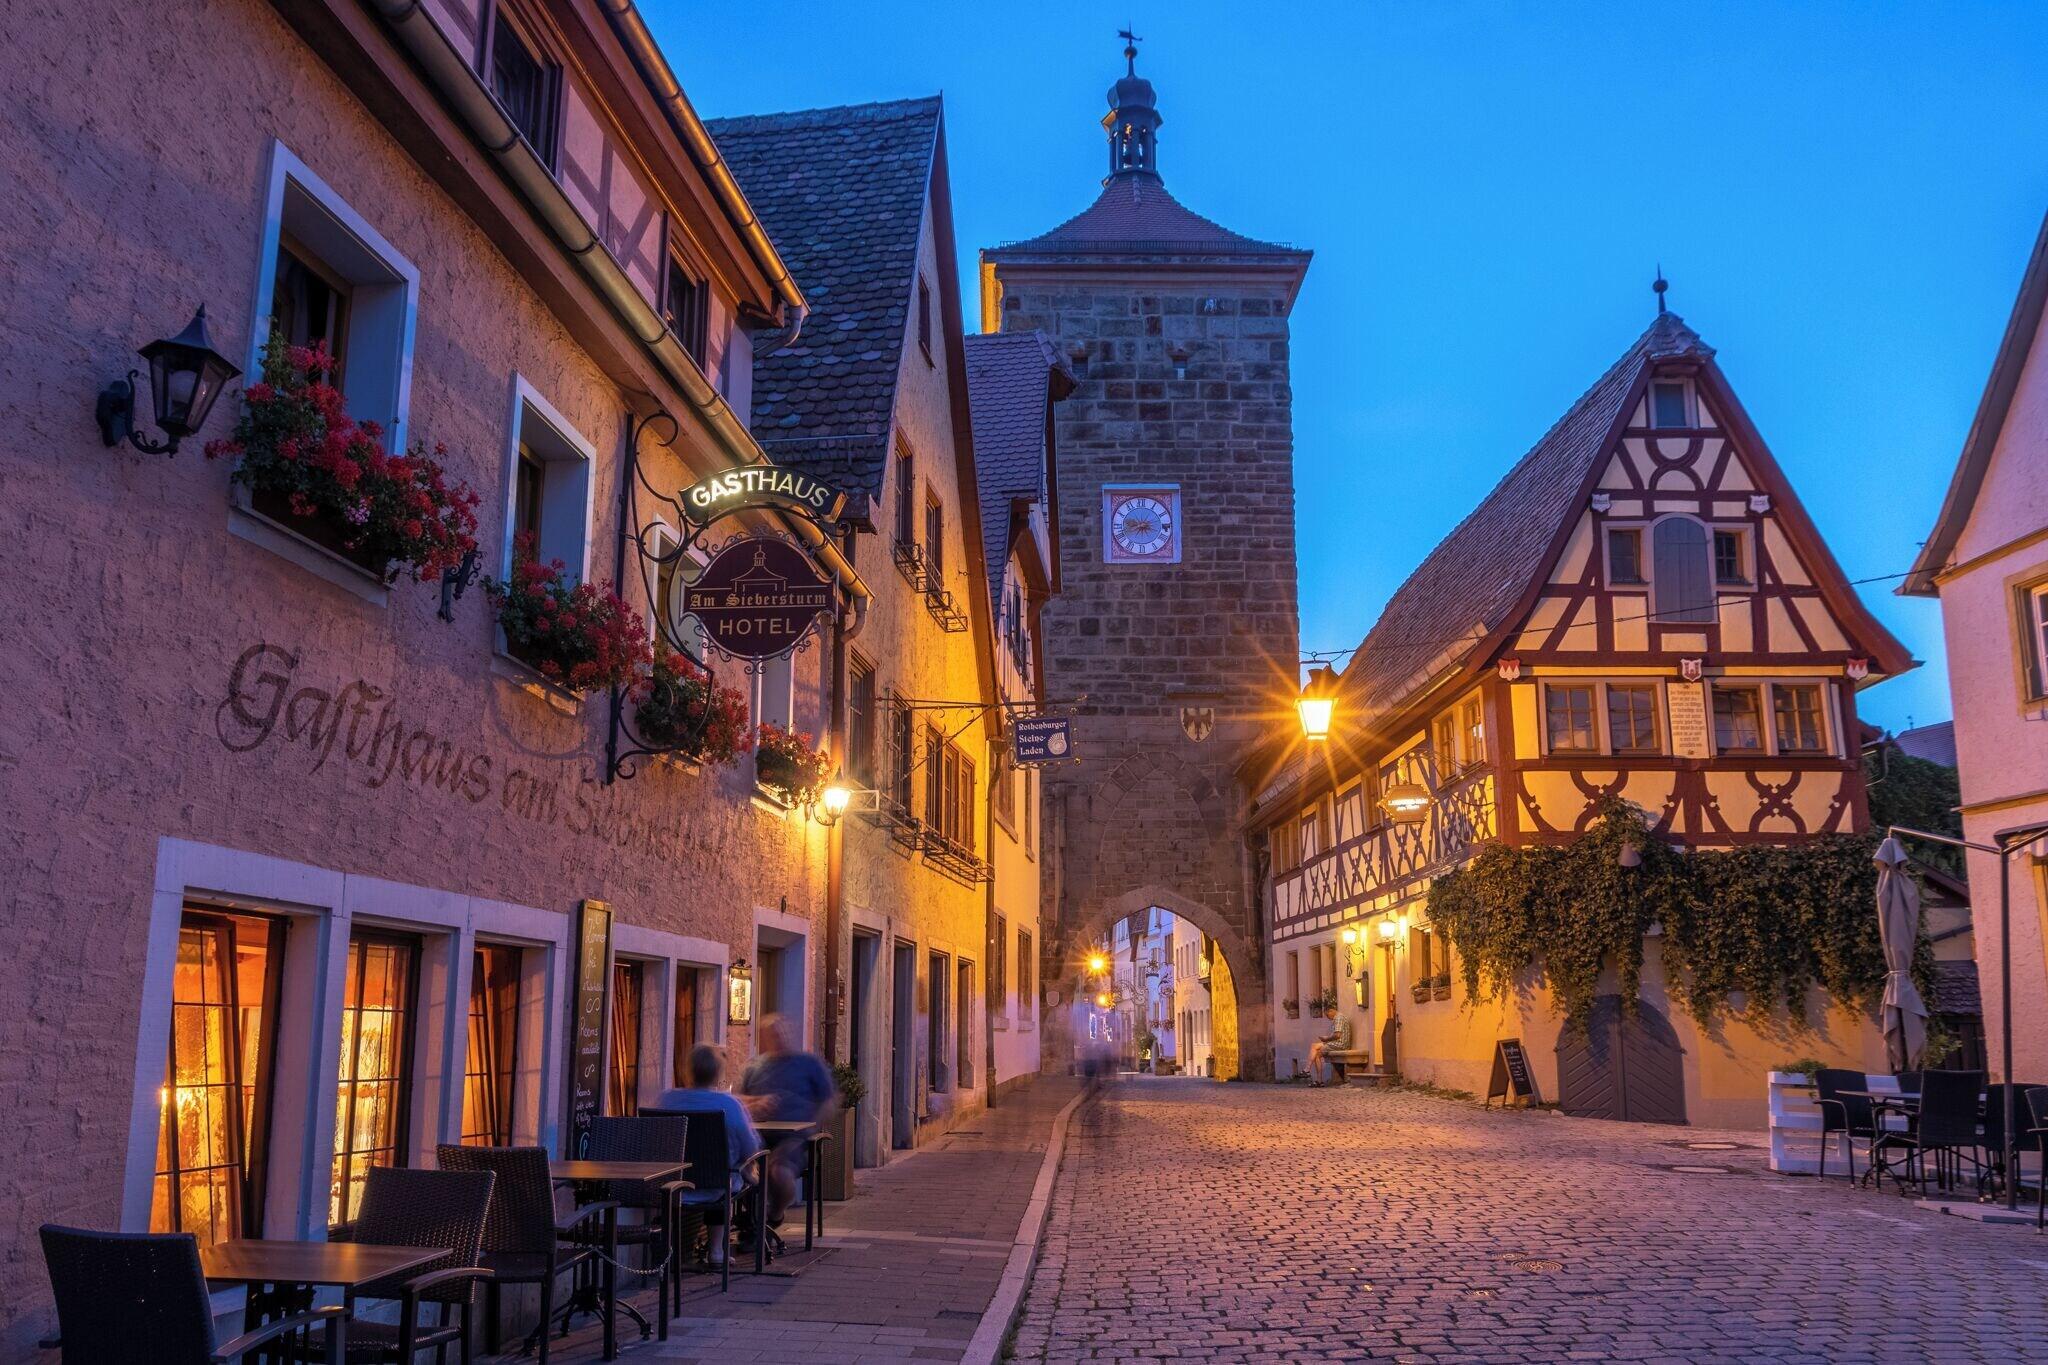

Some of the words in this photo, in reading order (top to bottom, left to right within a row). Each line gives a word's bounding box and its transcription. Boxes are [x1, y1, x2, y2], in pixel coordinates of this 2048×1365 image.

[692, 470, 830, 508] GASTHAUS
[690, 594, 715, 608] Am
[725, 592, 827, 607] Siebersturm
[719, 618, 797, 636] HOTEL
[1018, 721, 1066, 731] Rothenburger
[1020, 747, 1044, 756] Laden
[502, 768, 559, 825] am
